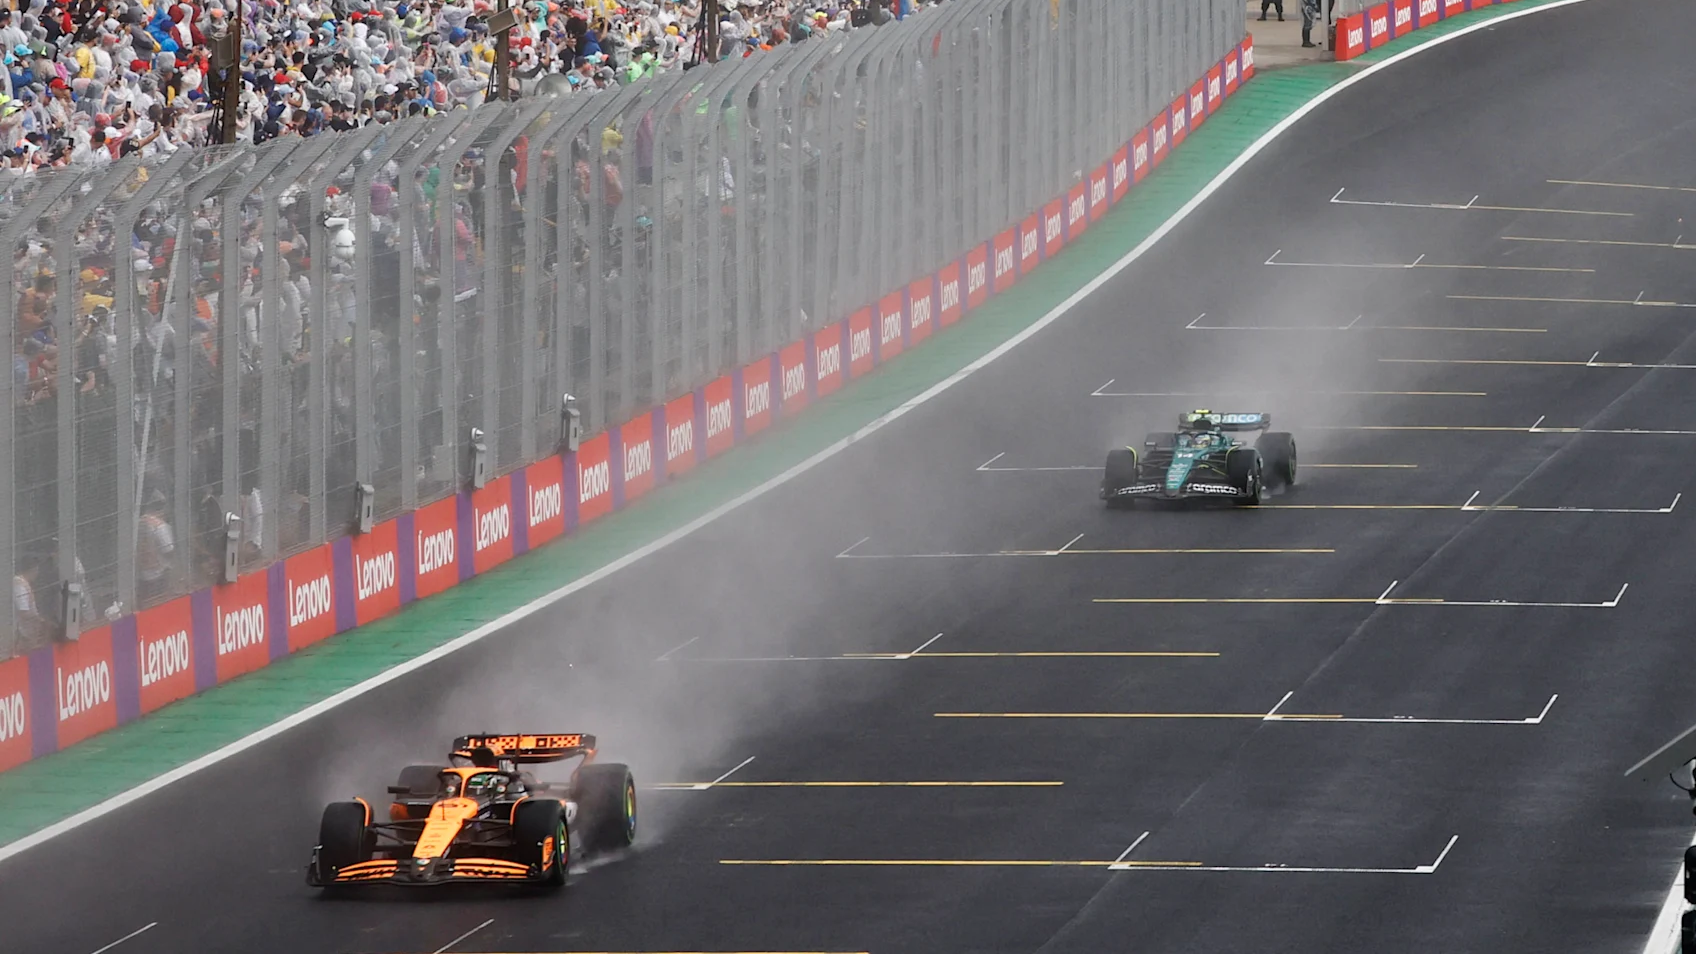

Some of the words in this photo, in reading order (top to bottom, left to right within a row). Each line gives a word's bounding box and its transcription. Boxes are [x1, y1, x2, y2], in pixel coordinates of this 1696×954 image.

[1371, 16, 1387, 38] Lenovo
[1395, 6, 1411, 27] Lenovo
[1348, 27, 1363, 48] Lenovo
[969, 262, 985, 293] Lenovo
[995, 246, 1013, 278] Lenovo
[911, 295, 930, 328] Lenovo
[941, 280, 959, 312] Lenovo
[850, 327, 870, 361] Lenovo
[881, 311, 901, 343] Lenovo
[817, 343, 839, 380] Lenovo
[745, 381, 769, 418] Lenovo
[782, 363, 804, 400] Lenovo
[706, 399, 731, 438] Lenovo
[667, 420, 693, 460] Lenovo
[624, 440, 651, 482] Lenovo
[579, 460, 609, 503] Lenovo
[1192, 483, 1237, 495] aramco
[529, 483, 561, 527] Lenovo
[475, 504, 509, 551] Lenovo
[418, 528, 454, 574] Lenovo
[356, 551, 394, 600] Lenovo
[289, 574, 330, 627] Lenovo
[217, 604, 264, 655] Lenovo
[140, 630, 188, 686] Lenovo
[58, 661, 110, 721] Lenovo
